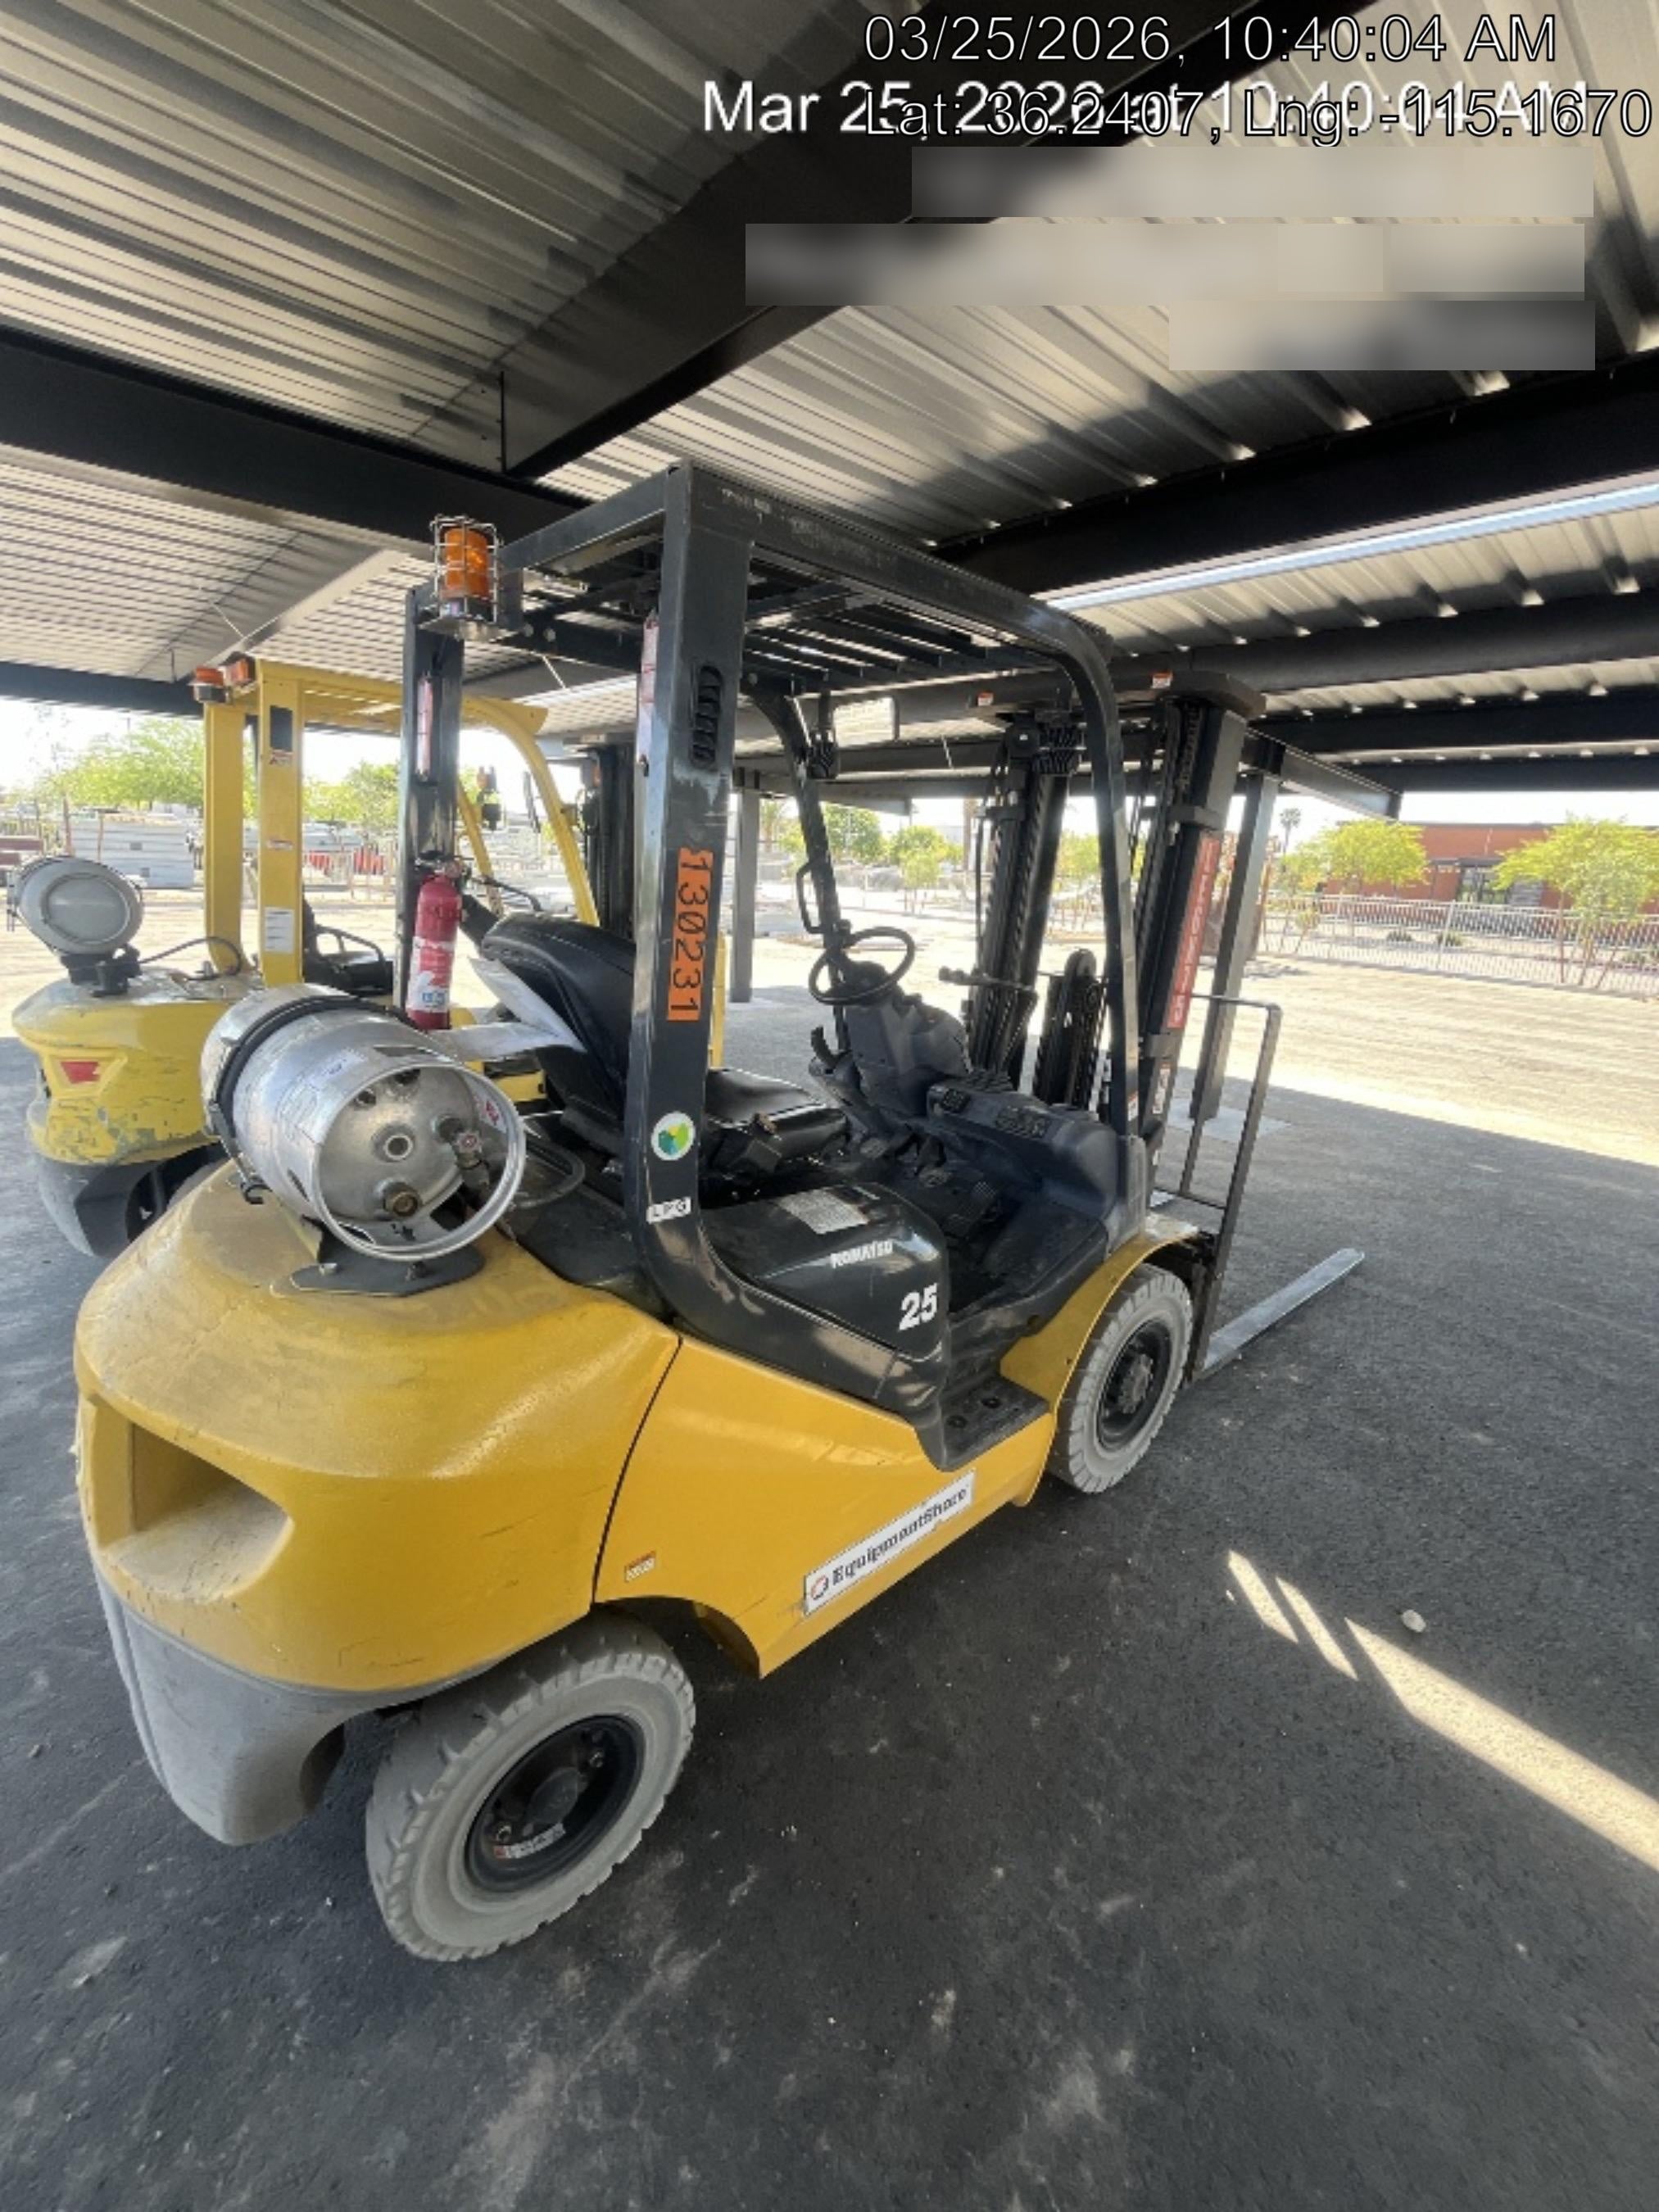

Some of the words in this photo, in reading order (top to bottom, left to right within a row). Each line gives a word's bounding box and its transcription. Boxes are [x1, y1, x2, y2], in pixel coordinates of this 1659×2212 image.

[670, 857, 711, 1011] 130231
[898, 1282, 939, 1331] 25
[832, 1488, 967, 1586] EquipmentShare
